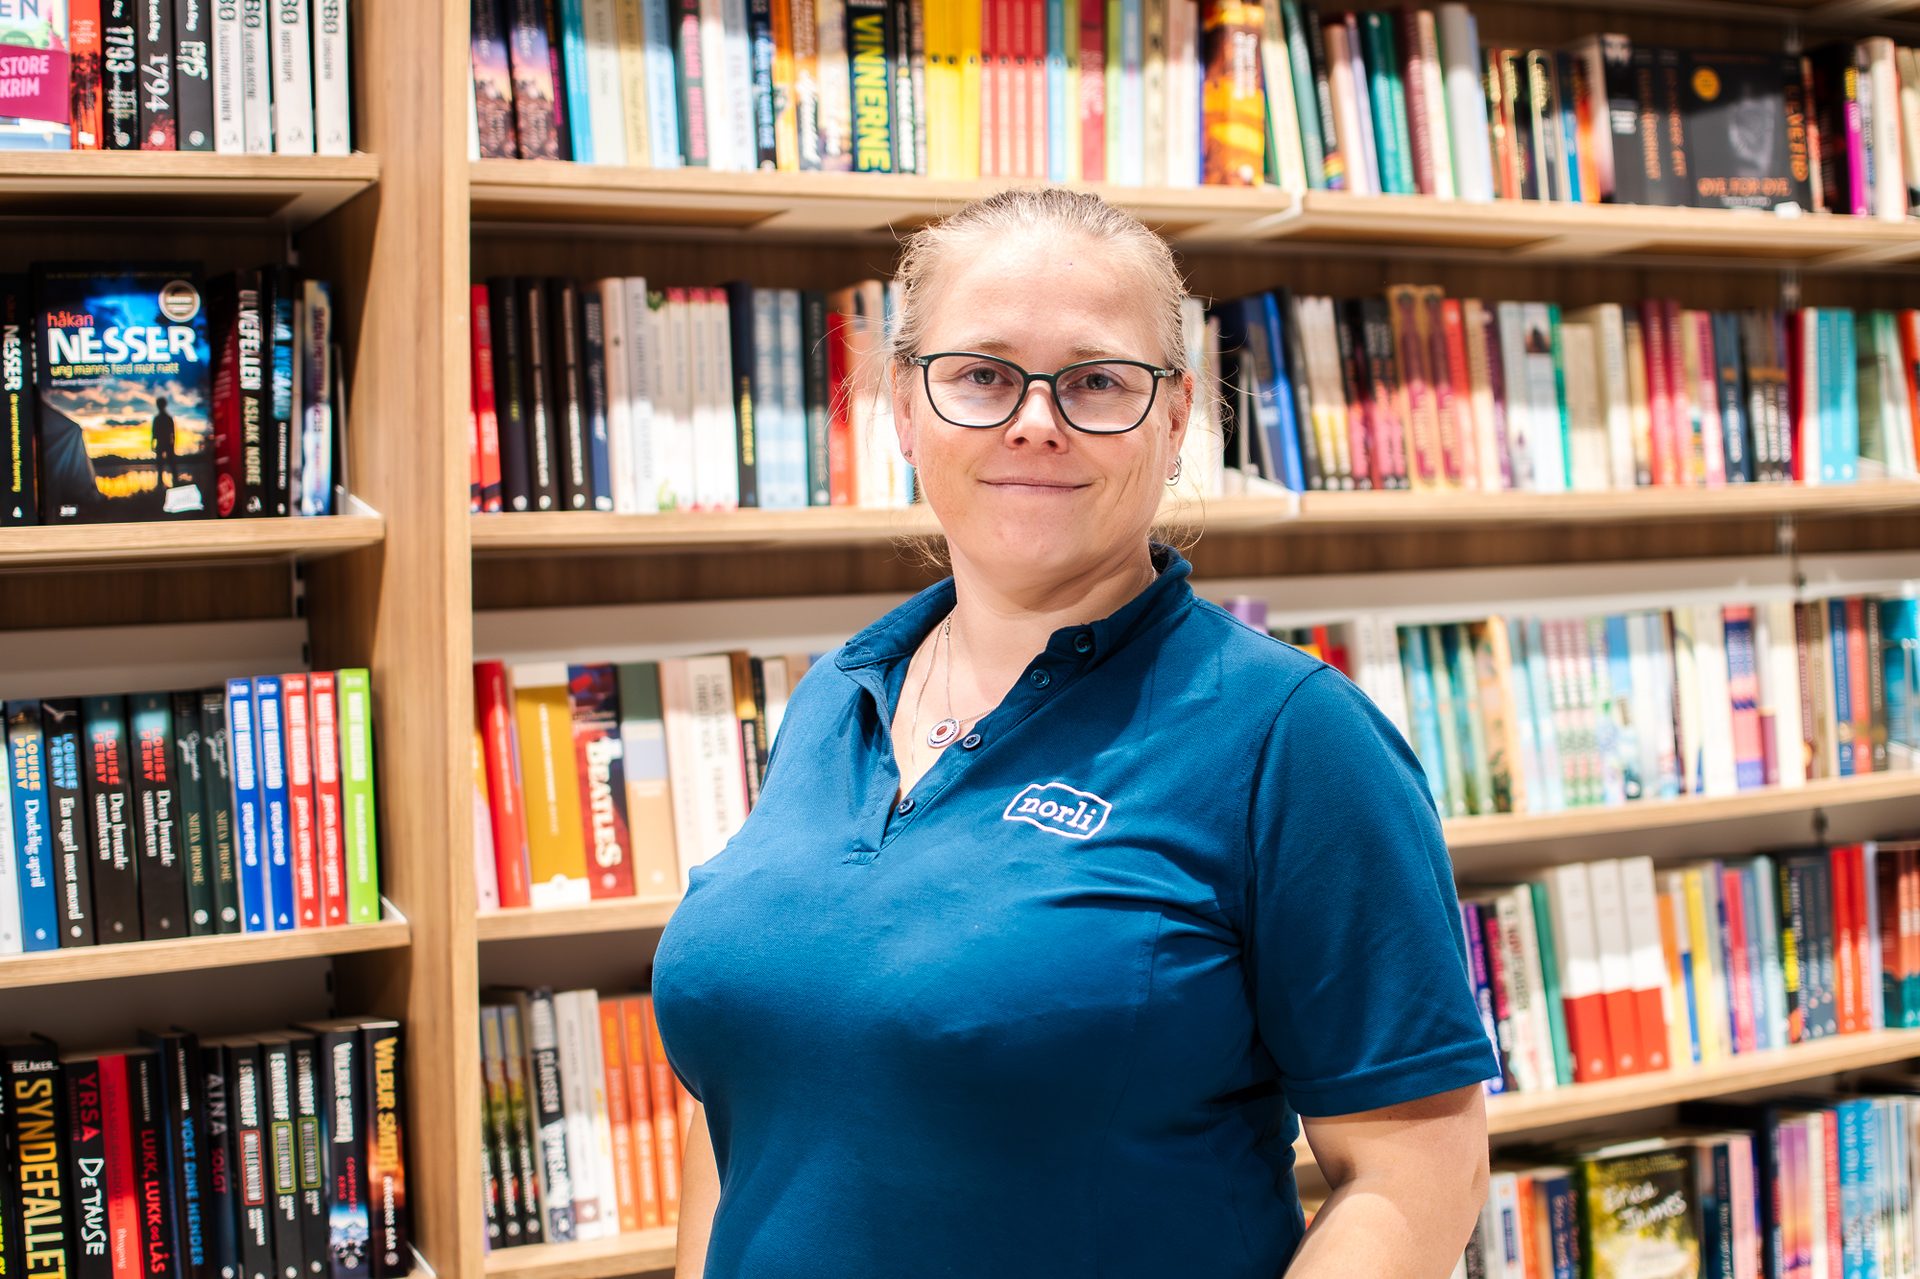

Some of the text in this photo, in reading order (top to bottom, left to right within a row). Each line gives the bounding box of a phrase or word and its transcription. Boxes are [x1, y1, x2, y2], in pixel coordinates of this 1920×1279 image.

[0, 55, 49, 76] STORE
[105, 25, 135, 72] 1793
[0, 77, 40, 97] KRIM
[141, 53, 170, 113] 1794
[853, 13, 893, 172] VINNERNE
[47, 311, 95, 327] håkan
[48, 326, 199, 364] NESSER
[239, 289, 262, 390] ULVEFELLEN
[3, 324, 23, 391] NESSER
[50, 365, 73, 378] ung
[74, 364, 110, 376] manns
[243, 396, 260, 444] ASLAK
[15, 737, 28, 789] PENNY
[26, 735, 41, 791] LOUISE
[51, 736, 65, 789] PENNY
[62, 733, 78, 790] LOUISE
[94, 733, 108, 784] PENNY
[105, 729, 120, 785] LOUISE
[141, 730, 155, 782] PENNY
[152, 727, 167, 783] LOUISE
[156, 790, 176, 867] Den brutale
[585, 736, 624, 868] BEATLES
[1017, 797, 1097, 831] norli
[109, 792, 129, 871] Den brutale
[26, 857, 46, 888] april
[58, 797, 84, 920] En regel mot mord
[79, 1073, 101, 1143] YRSA
[207, 1073, 229, 1136] AINA
[333, 1042, 355, 1144] WILBUR SMITH
[374, 1037, 400, 1172] WILBUR SMITH
[141, 1129, 156, 1180] LUKK,
[181, 1117, 196, 1158] VOKT
[184, 1160, 199, 1199] DINE
[211, 1147, 227, 1194] SOLGT
[81, 1189, 108, 1256] TAUSE
[145, 1180, 162, 1227] LUKK
[150, 1241, 170, 1274] LÅS
[187, 1202, 205, 1266] HENDER
